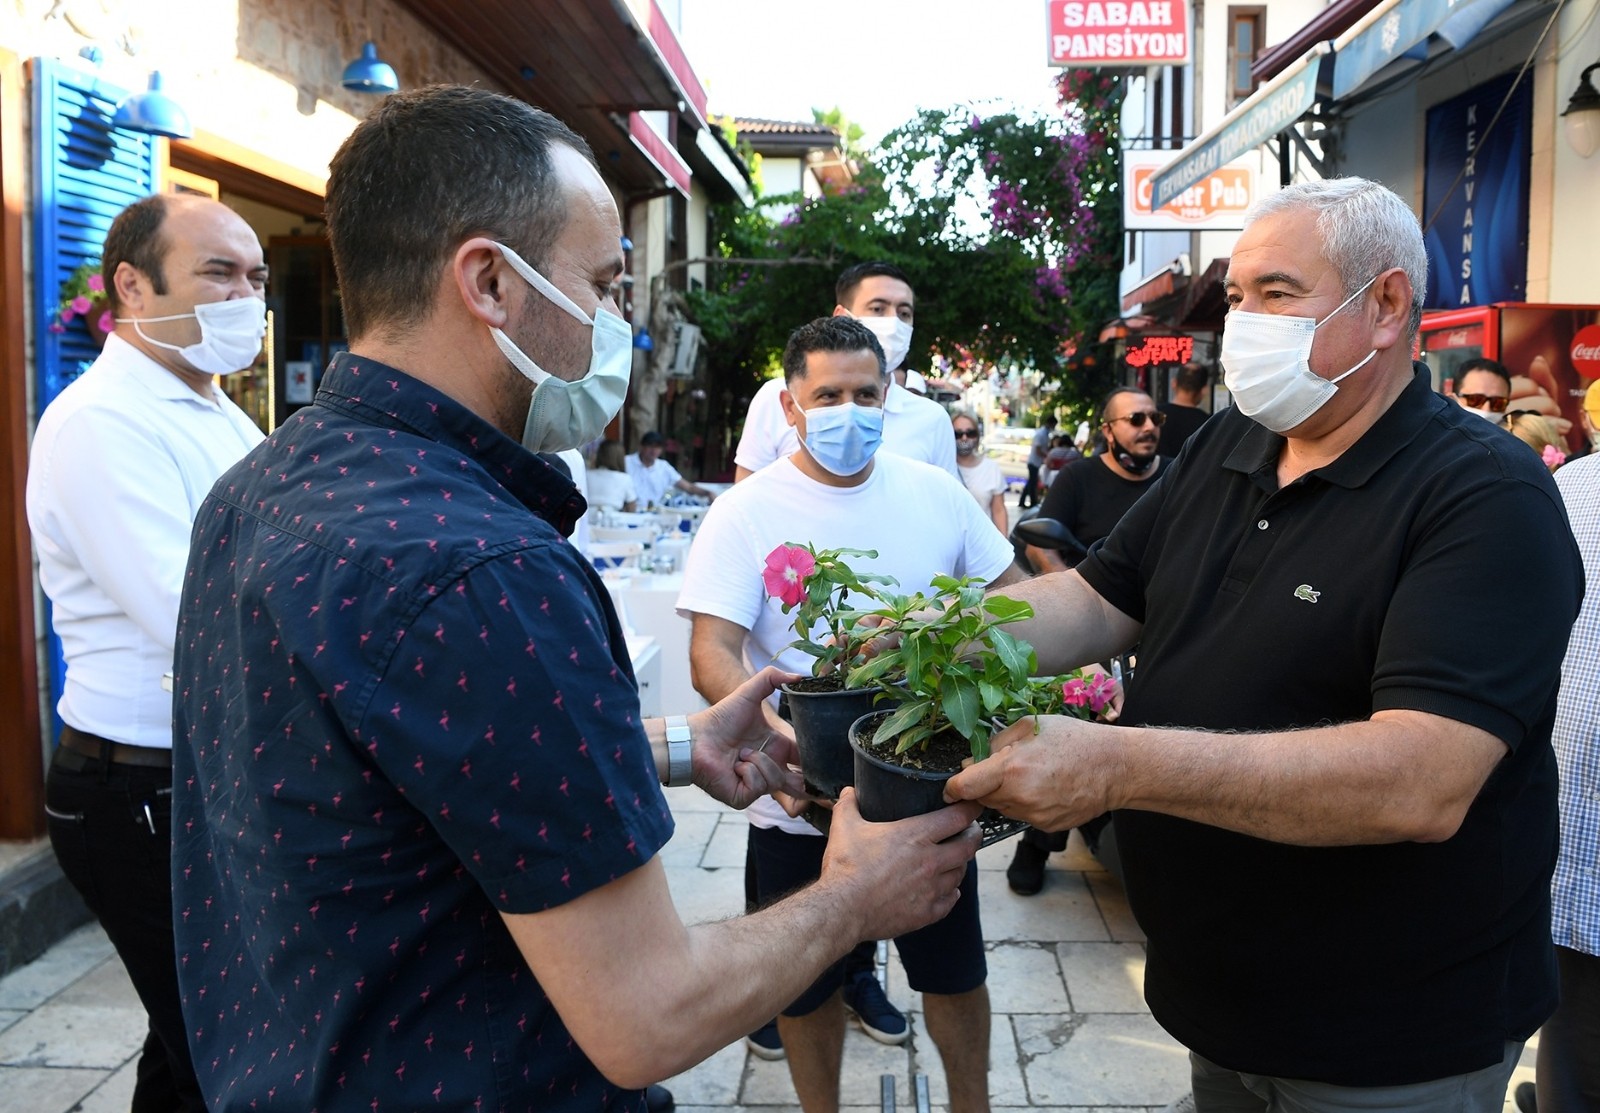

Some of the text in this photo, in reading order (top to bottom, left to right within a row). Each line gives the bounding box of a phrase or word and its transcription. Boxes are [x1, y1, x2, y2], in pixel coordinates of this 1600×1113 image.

[1063, 2, 1172, 27] SABAH
[1053, 27, 1184, 58] PANSİYON
[1269, 80, 1305, 128] SHOP
[1210, 177, 1248, 207] Pub
